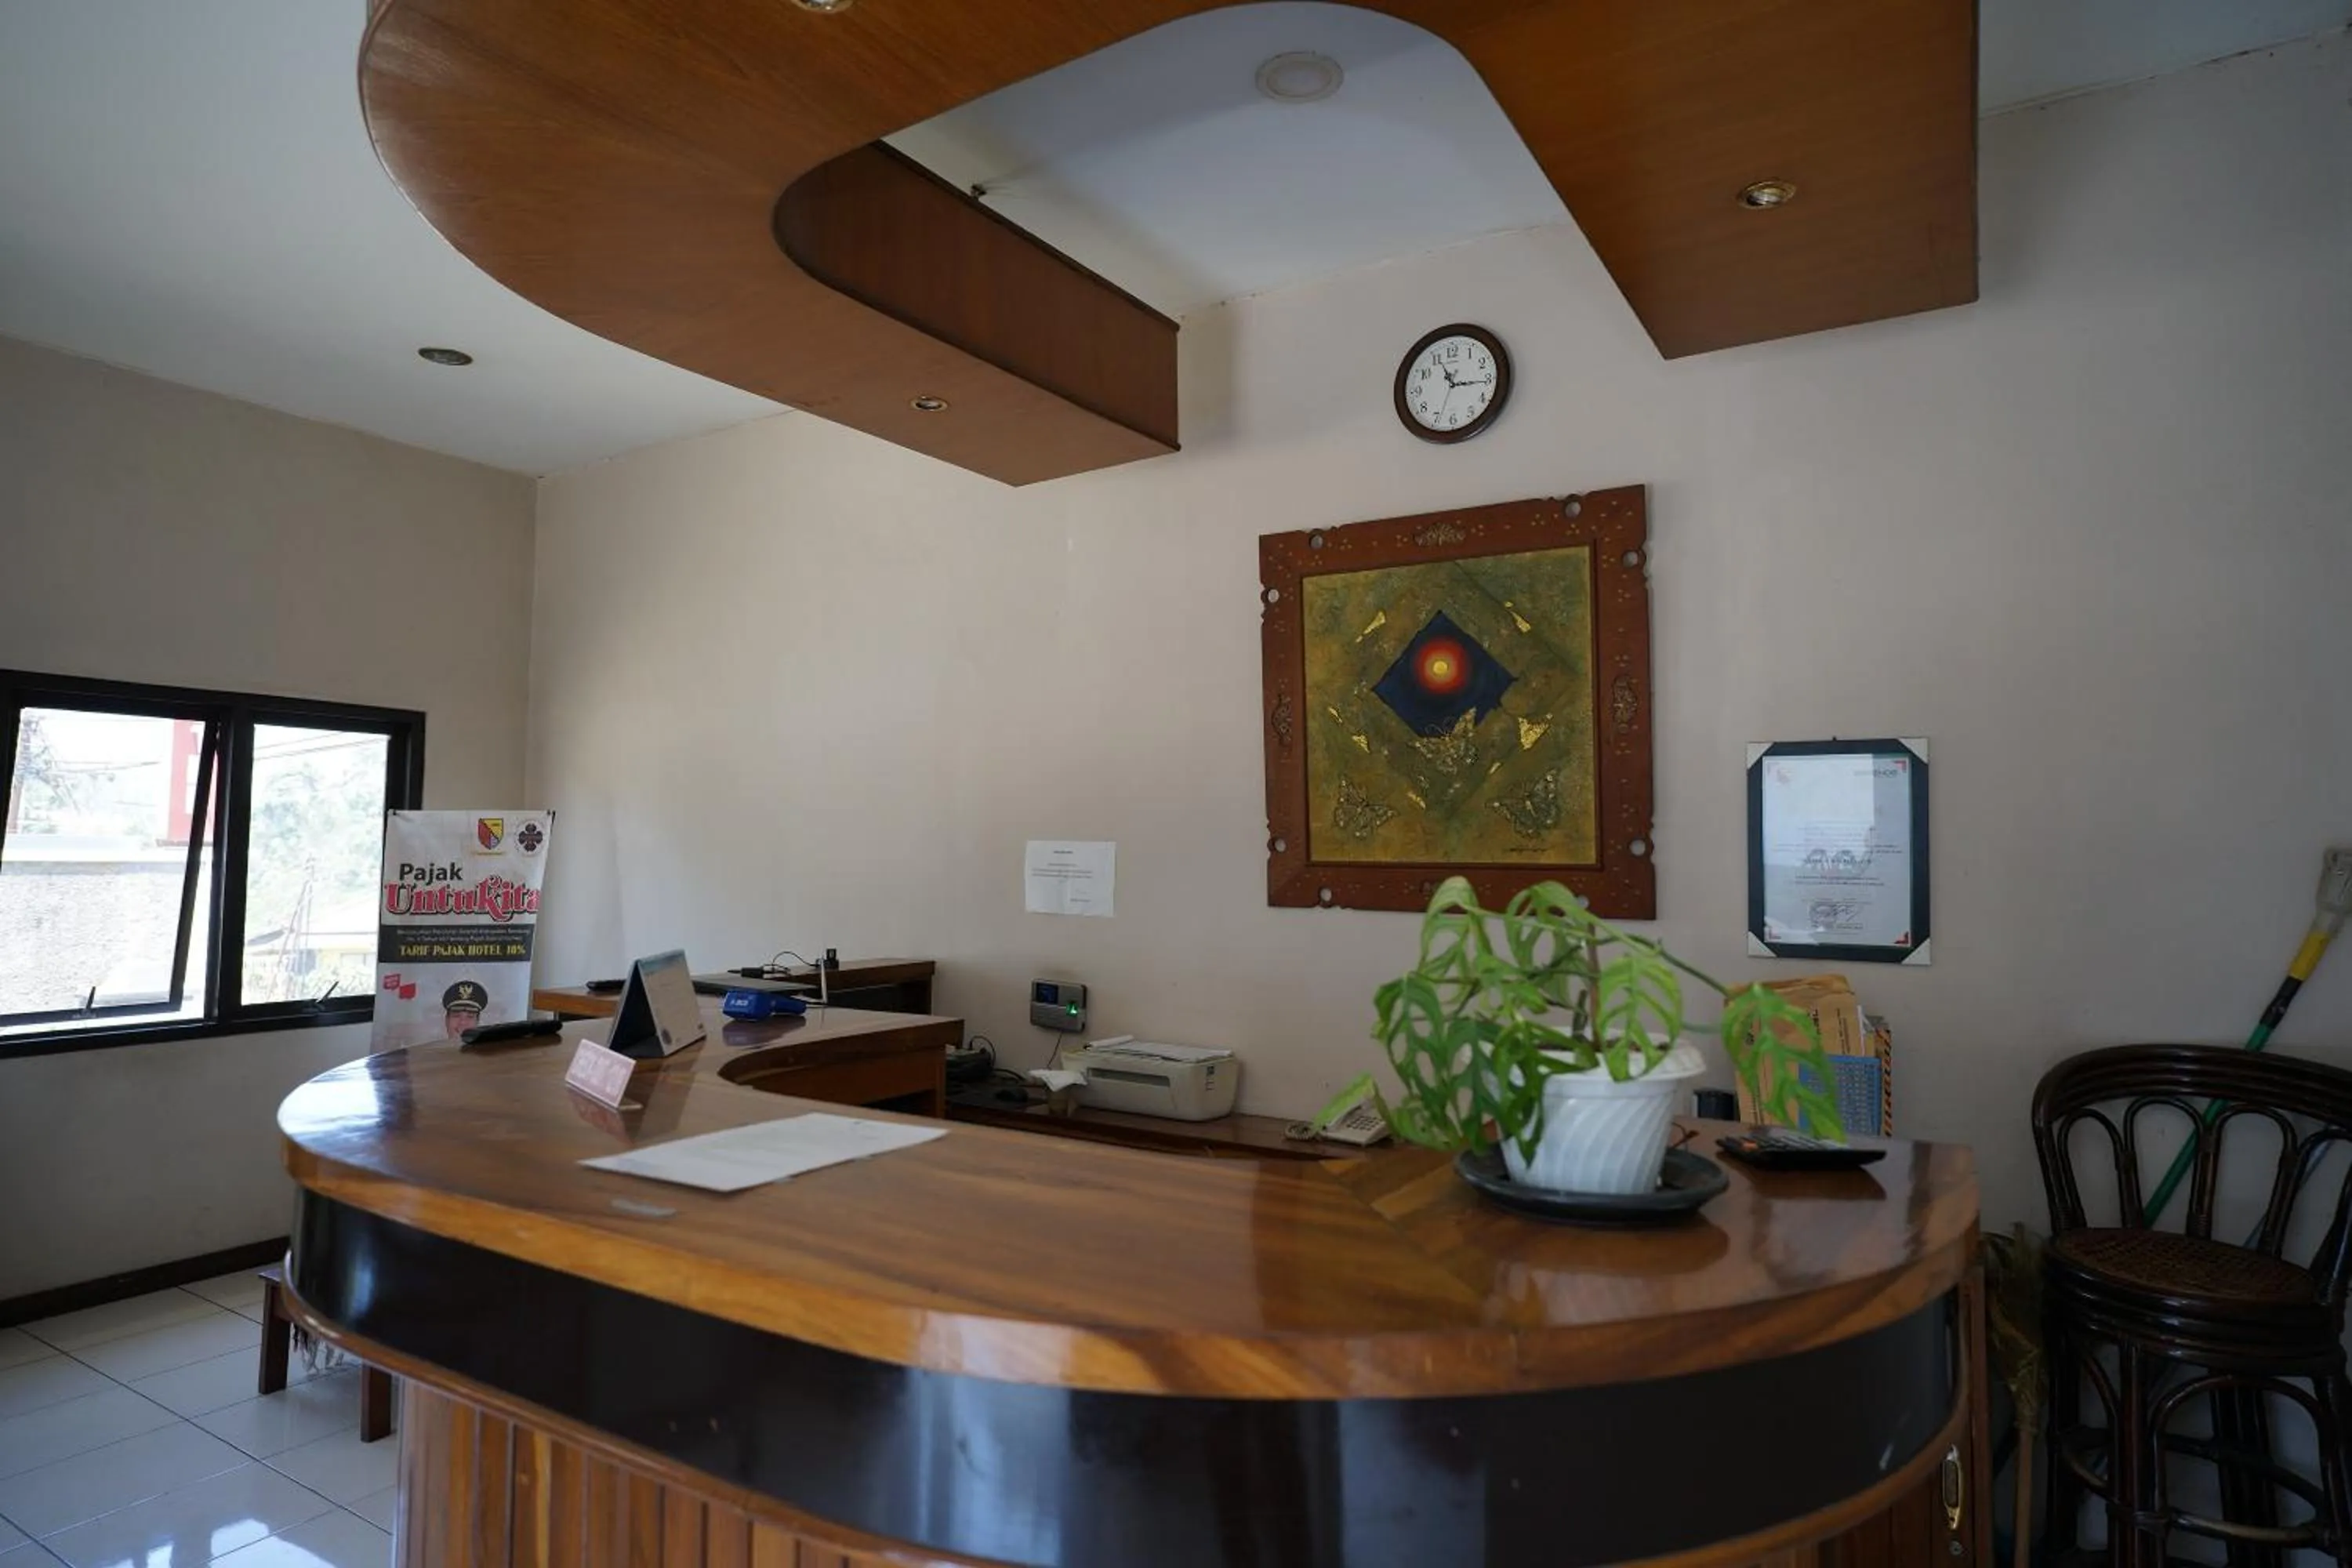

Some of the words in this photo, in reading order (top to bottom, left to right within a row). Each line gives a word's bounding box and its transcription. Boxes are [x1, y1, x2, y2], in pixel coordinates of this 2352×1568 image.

[1446, 345, 1459, 358] 12
[1467, 347, 1472, 359] 1
[1478, 357, 1486, 369] 2
[1484, 372, 1492, 386] 3
[1414, 385, 1423, 398] 9
[1479, 391, 1486, 404] 4
[1420, 401, 1428, 413] 8
[1467, 405, 1475, 418] 5
[1433, 412, 1440, 424] 7
[1449, 412, 1457, 425] 6
[399, 862, 463, 886] Pajak
[400, 945, 430, 956] TARIF
[432, 945, 466, 956] PAJAK
[468, 944, 503, 956] HOTEL
[506, 943, 526, 955] 10%
